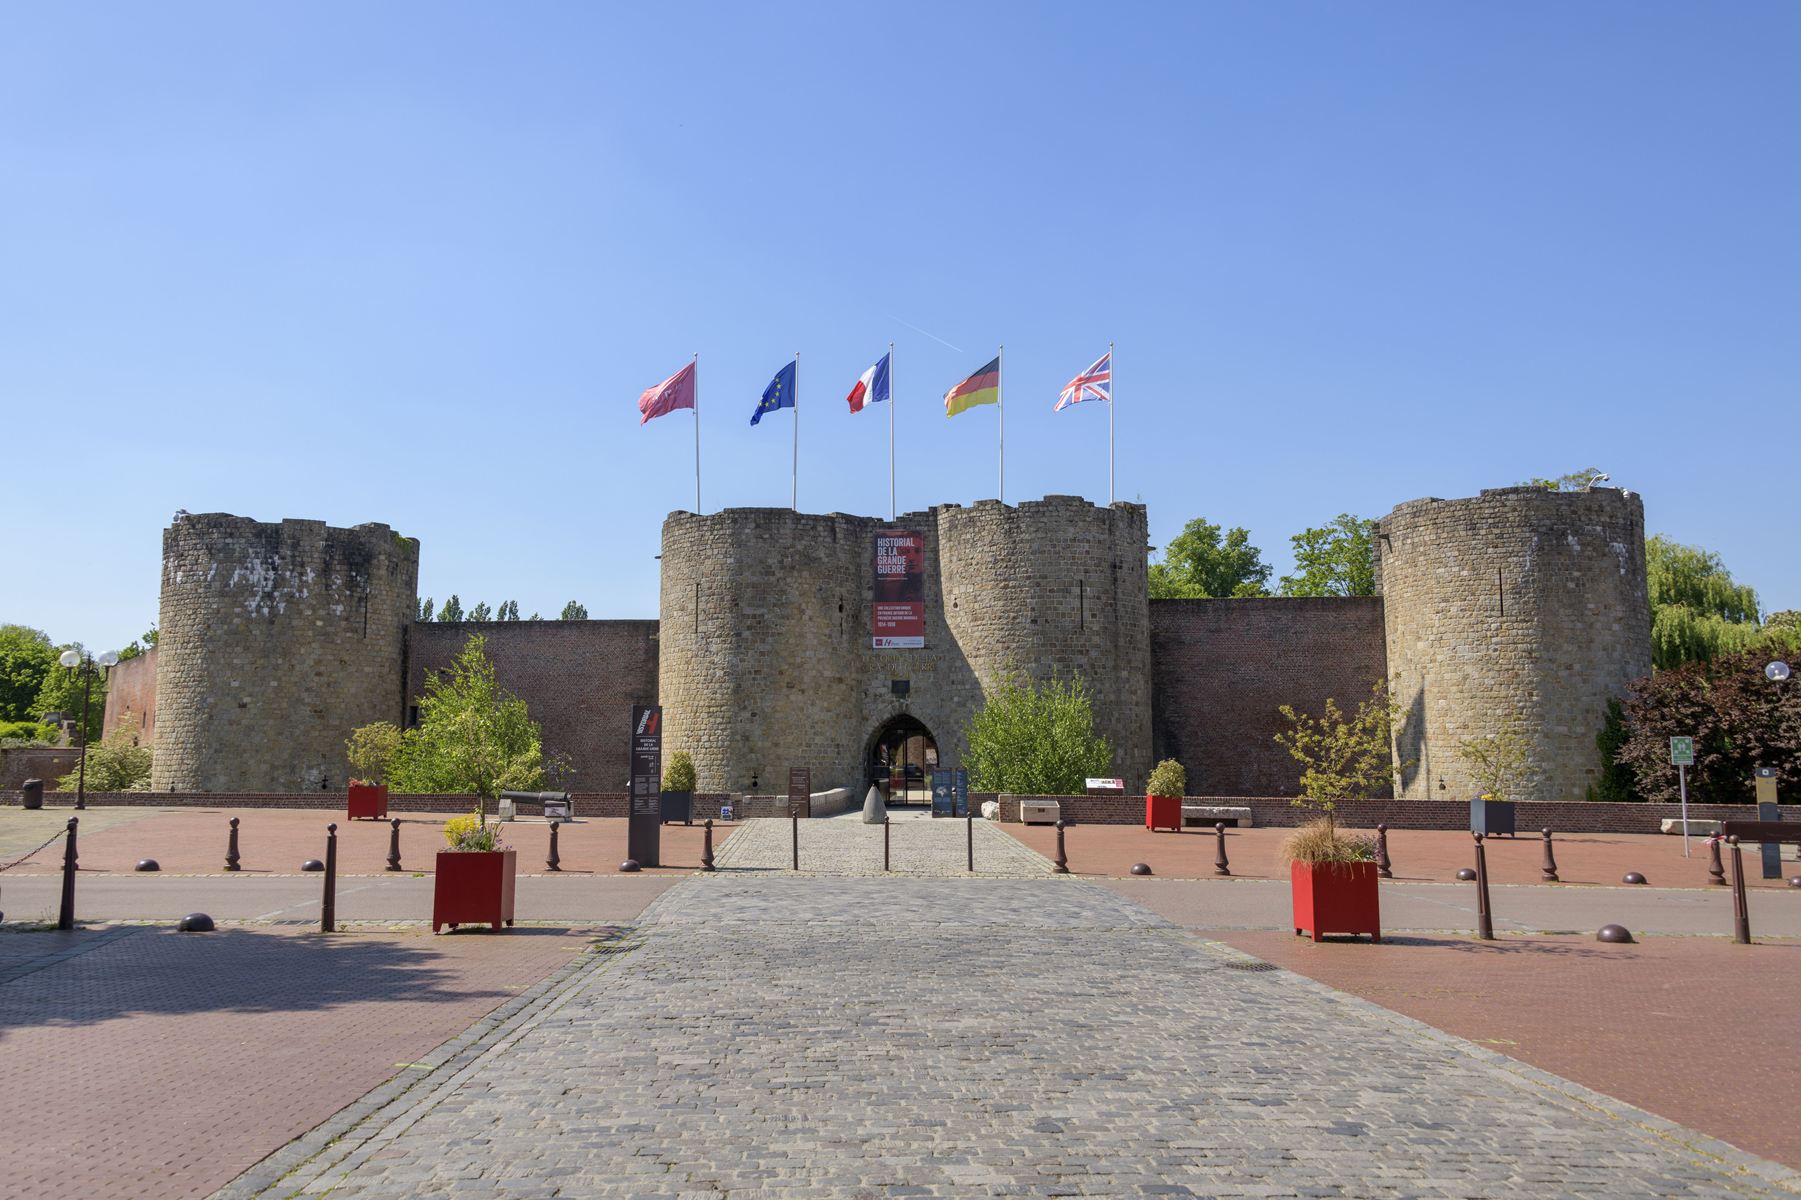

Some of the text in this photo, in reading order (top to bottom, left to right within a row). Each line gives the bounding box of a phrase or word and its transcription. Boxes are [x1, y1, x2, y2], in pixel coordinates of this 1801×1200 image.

[878, 537, 915, 547] HISTORIAL
[878, 547, 898, 556] DE LA
[878, 556, 907, 565] GRANDE
[878, 565, 906, 574] GUERRE
